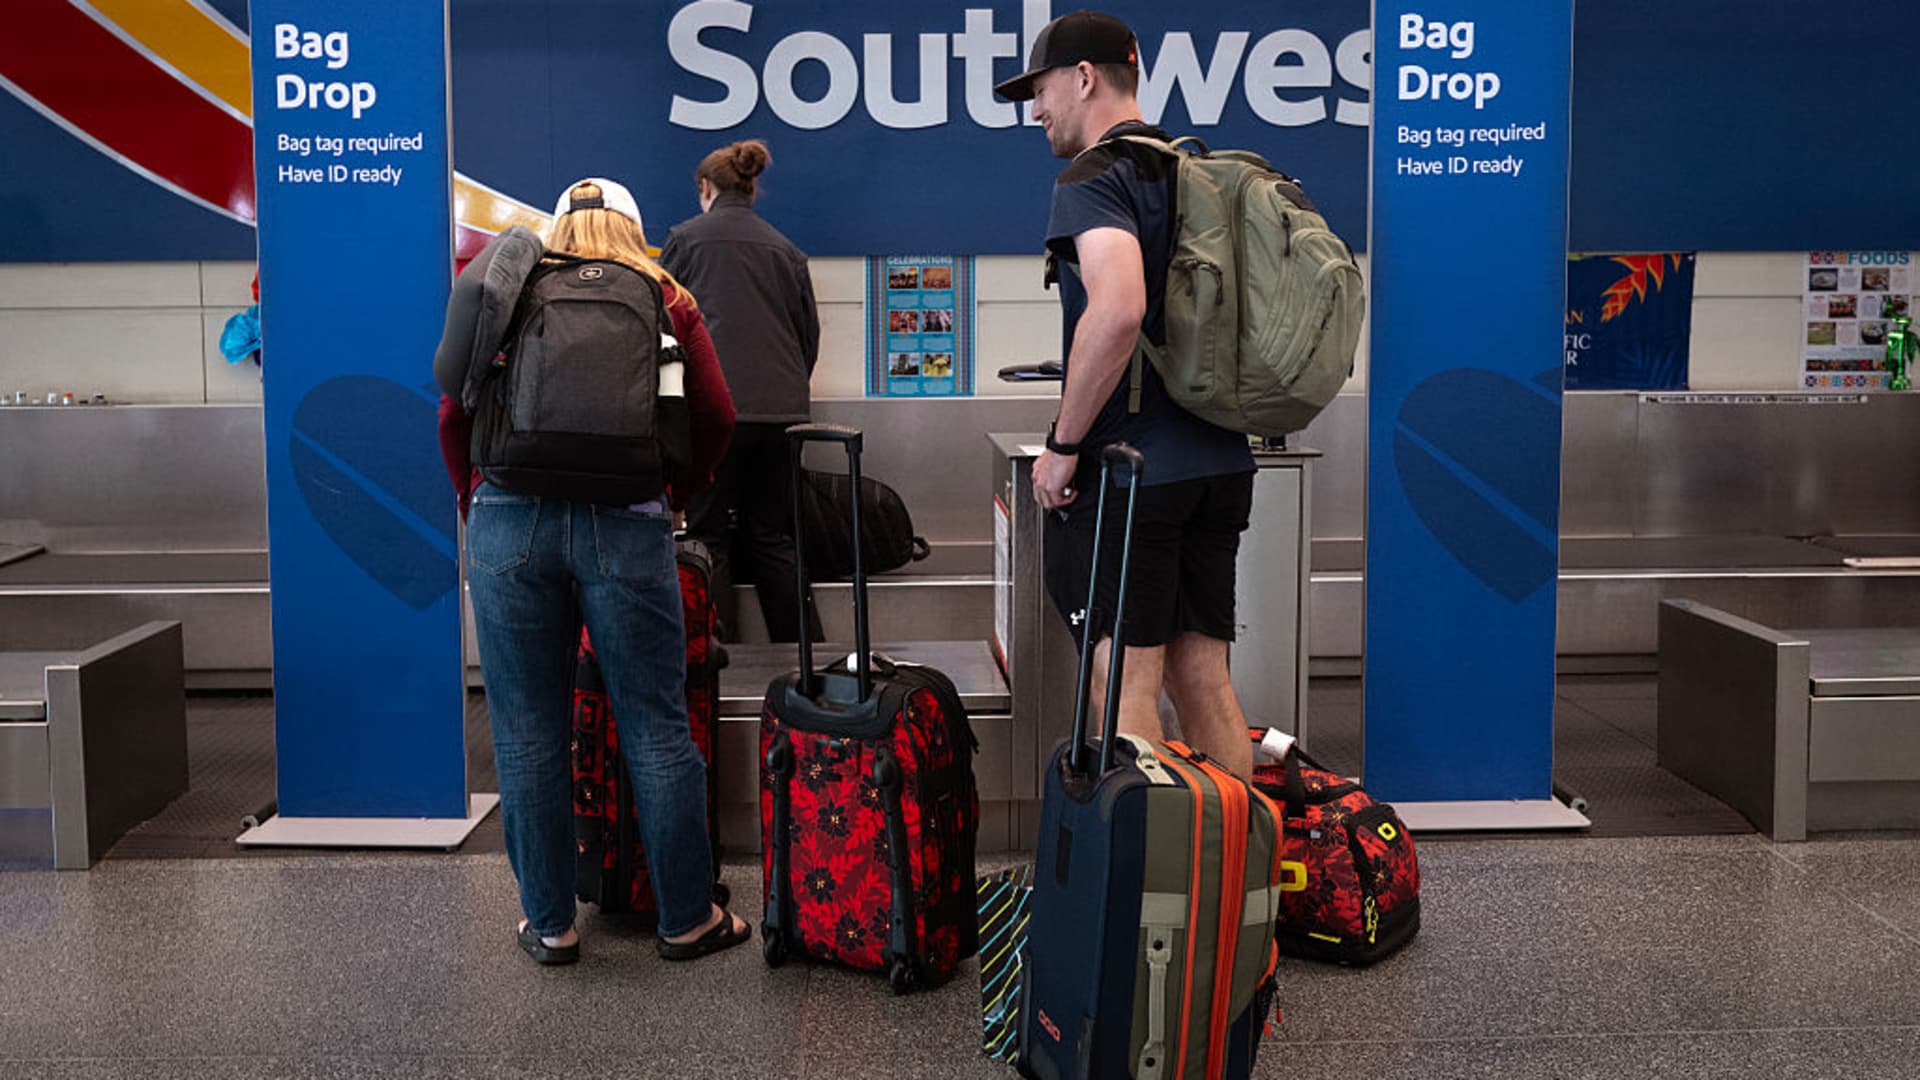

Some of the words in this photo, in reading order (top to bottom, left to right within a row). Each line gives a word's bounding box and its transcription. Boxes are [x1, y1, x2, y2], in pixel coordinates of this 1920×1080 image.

[274, 23, 349, 69] Bag
[1399, 13, 1475, 59] Bag
[276, 74, 377, 119] Drop
[1398, 65, 1501, 109] Drop
[277, 133, 311, 157] Bag
[315, 135, 344, 157] tag
[348, 132, 423, 156] required
[1397, 125, 1431, 148] Bag
[1436, 127, 1465, 147] tag
[1469, 121, 1546, 146] required
[278, 164, 323, 183] Have
[328, 164, 348, 183] ID
[352, 164, 402, 186] ready
[1397, 157, 1443, 175] Have
[1448, 156, 1469, 174] ID
[1473, 154, 1524, 177] ready
[1848, 251, 1910, 265] FOODS
